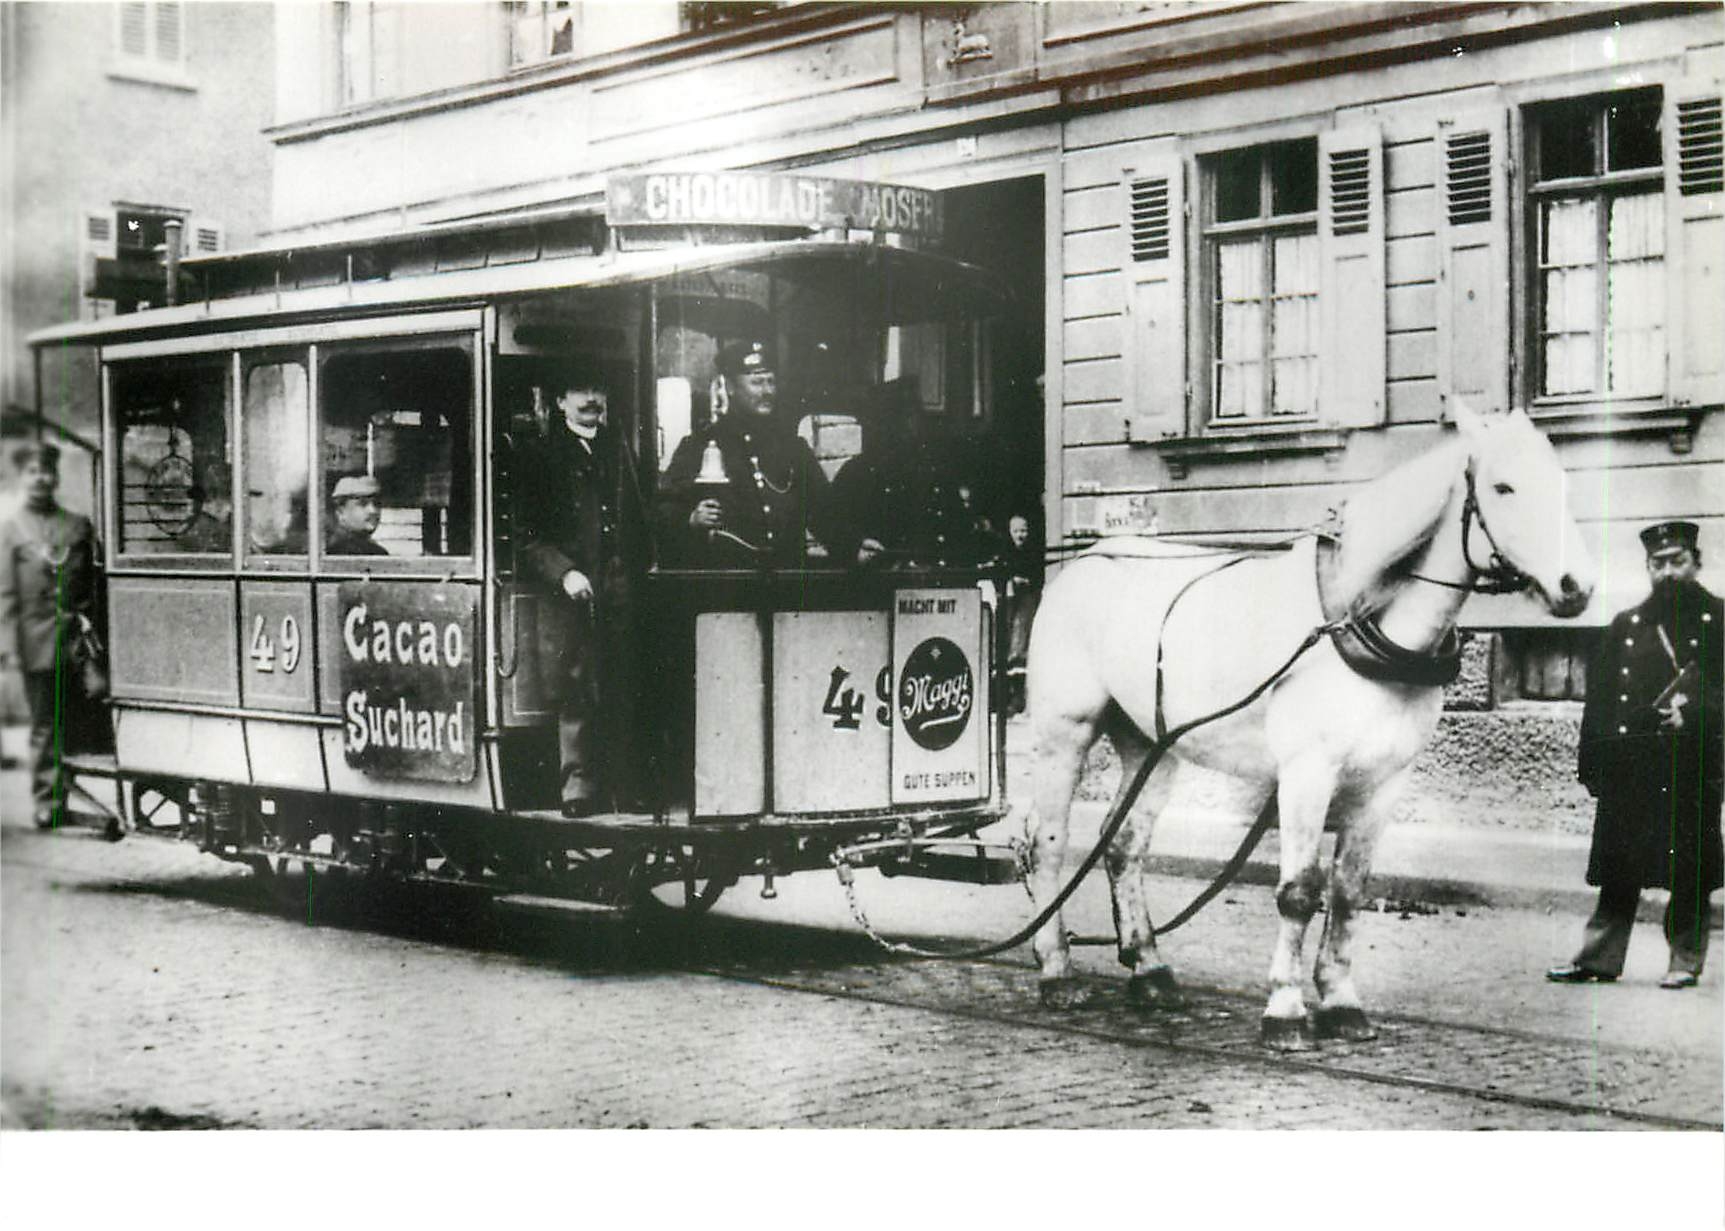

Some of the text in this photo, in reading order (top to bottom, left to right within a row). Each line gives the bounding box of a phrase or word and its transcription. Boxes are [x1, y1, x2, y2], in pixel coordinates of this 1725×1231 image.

[645, 173, 834, 219] CHOCOLADE
[899, 599, 957, 614] MACHT MIT
[250, 614, 300, 674] 49
[344, 603, 463, 667] Cacao
[902, 667, 969, 720] Maggi
[346, 690, 465, 753] Suchard
[904, 771, 976, 789] GUTE SUPPEN
